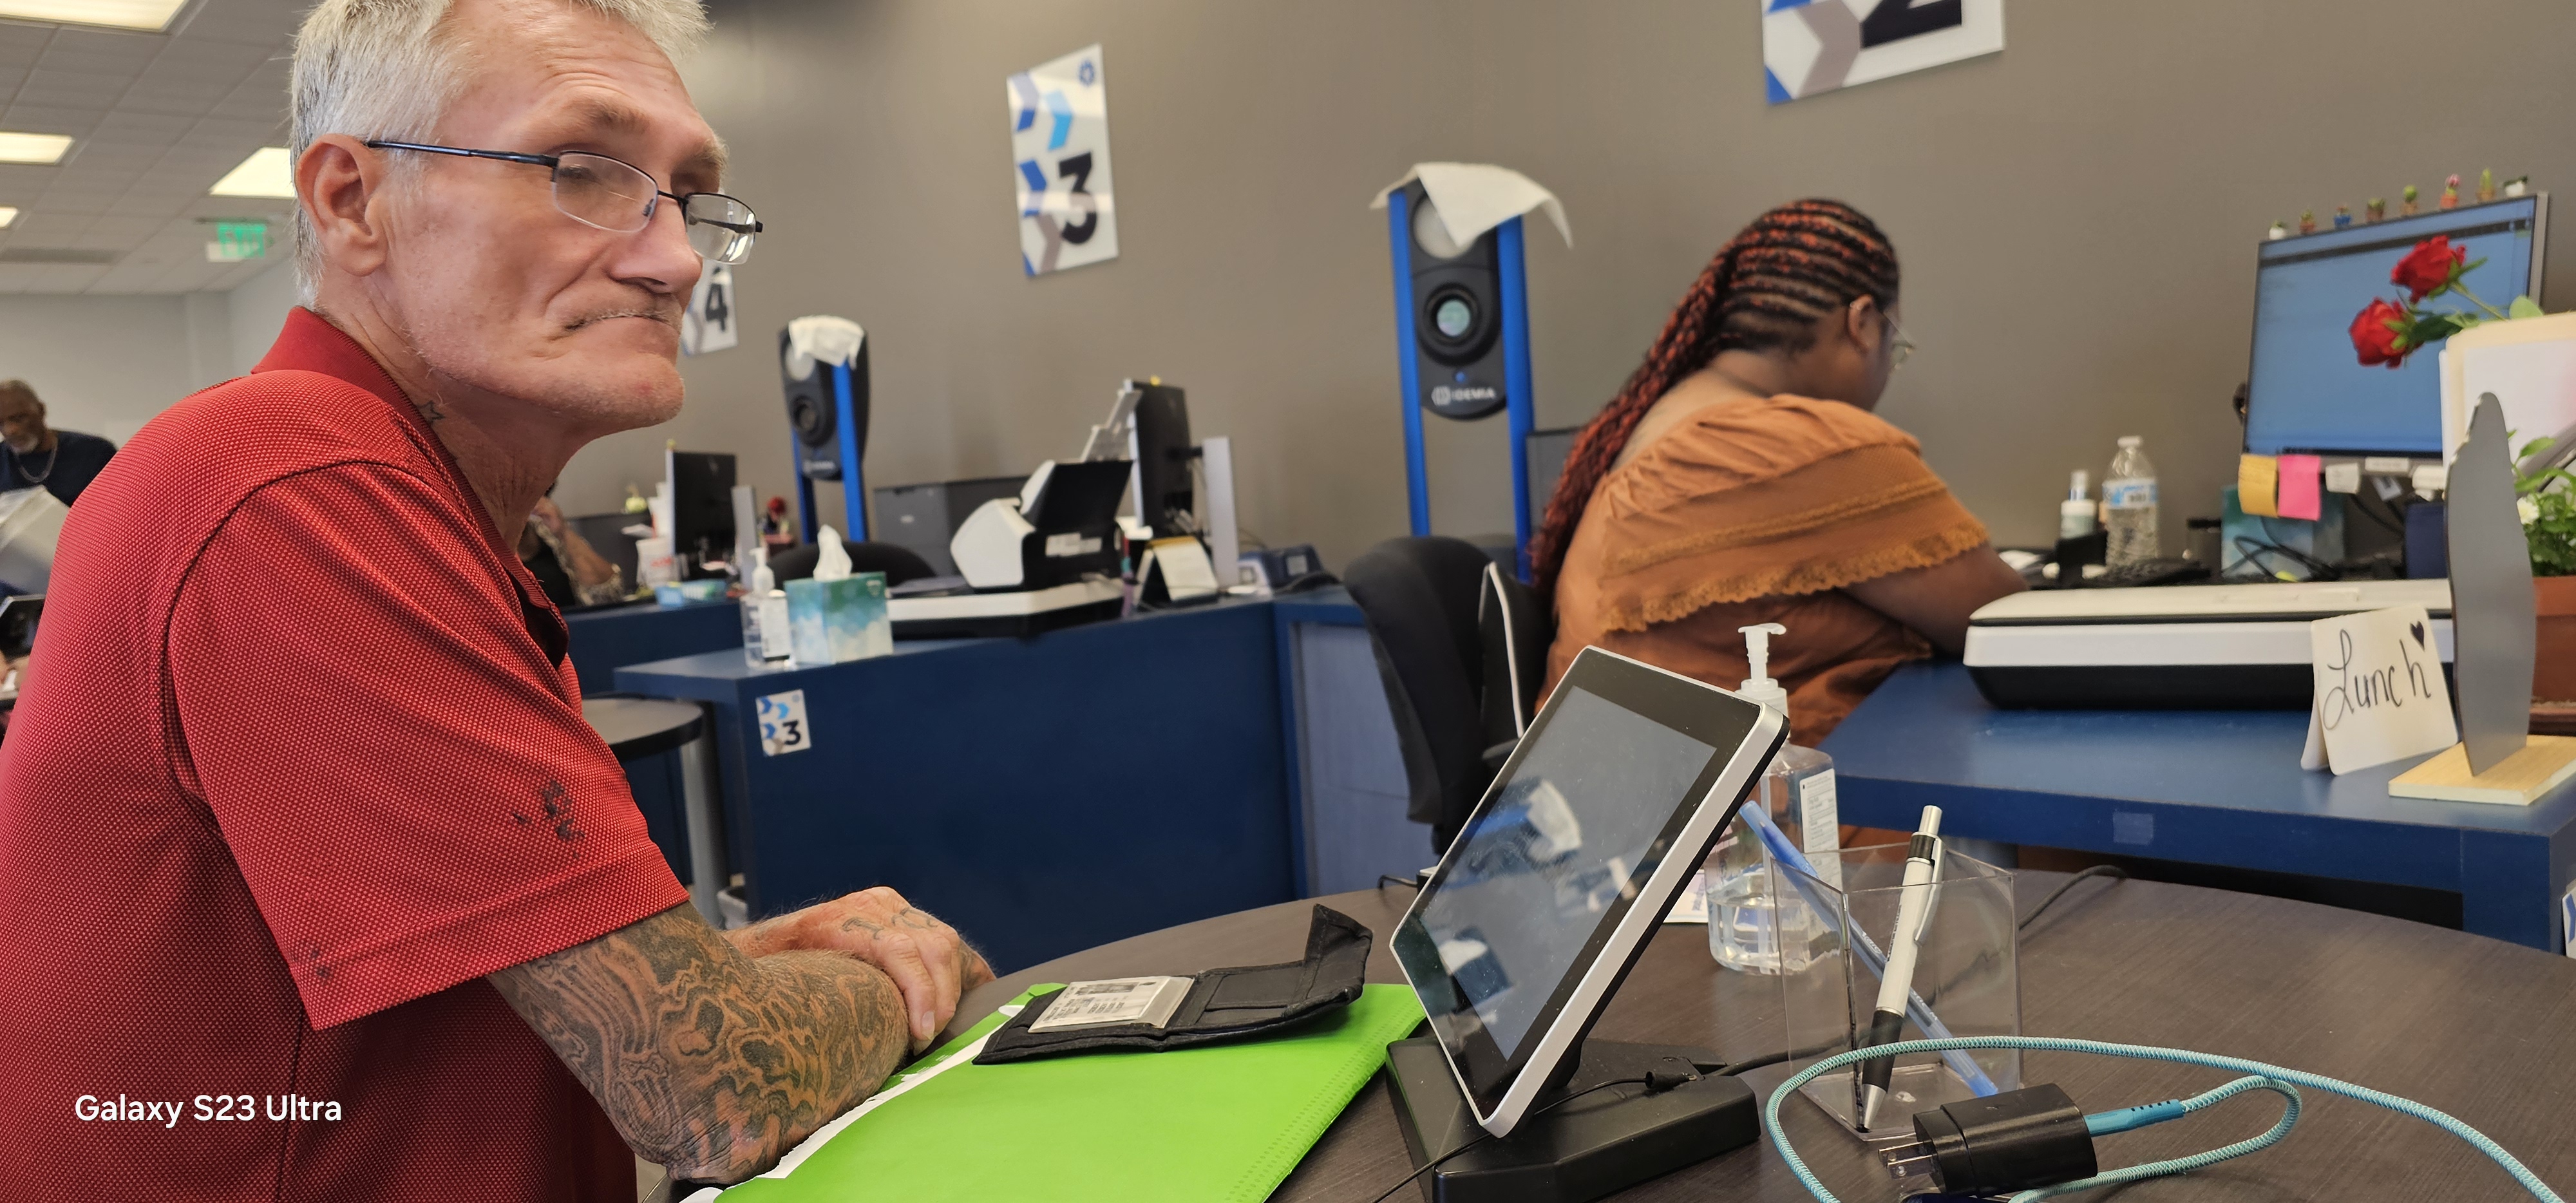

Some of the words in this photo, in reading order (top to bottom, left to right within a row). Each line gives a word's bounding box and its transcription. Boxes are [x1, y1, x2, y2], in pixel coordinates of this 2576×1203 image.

[1059, 151, 1097, 245] 3
[705, 266, 728, 333] 4
[2322, 628, 2432, 732] Lunch
[781, 719, 801, 745] 3
